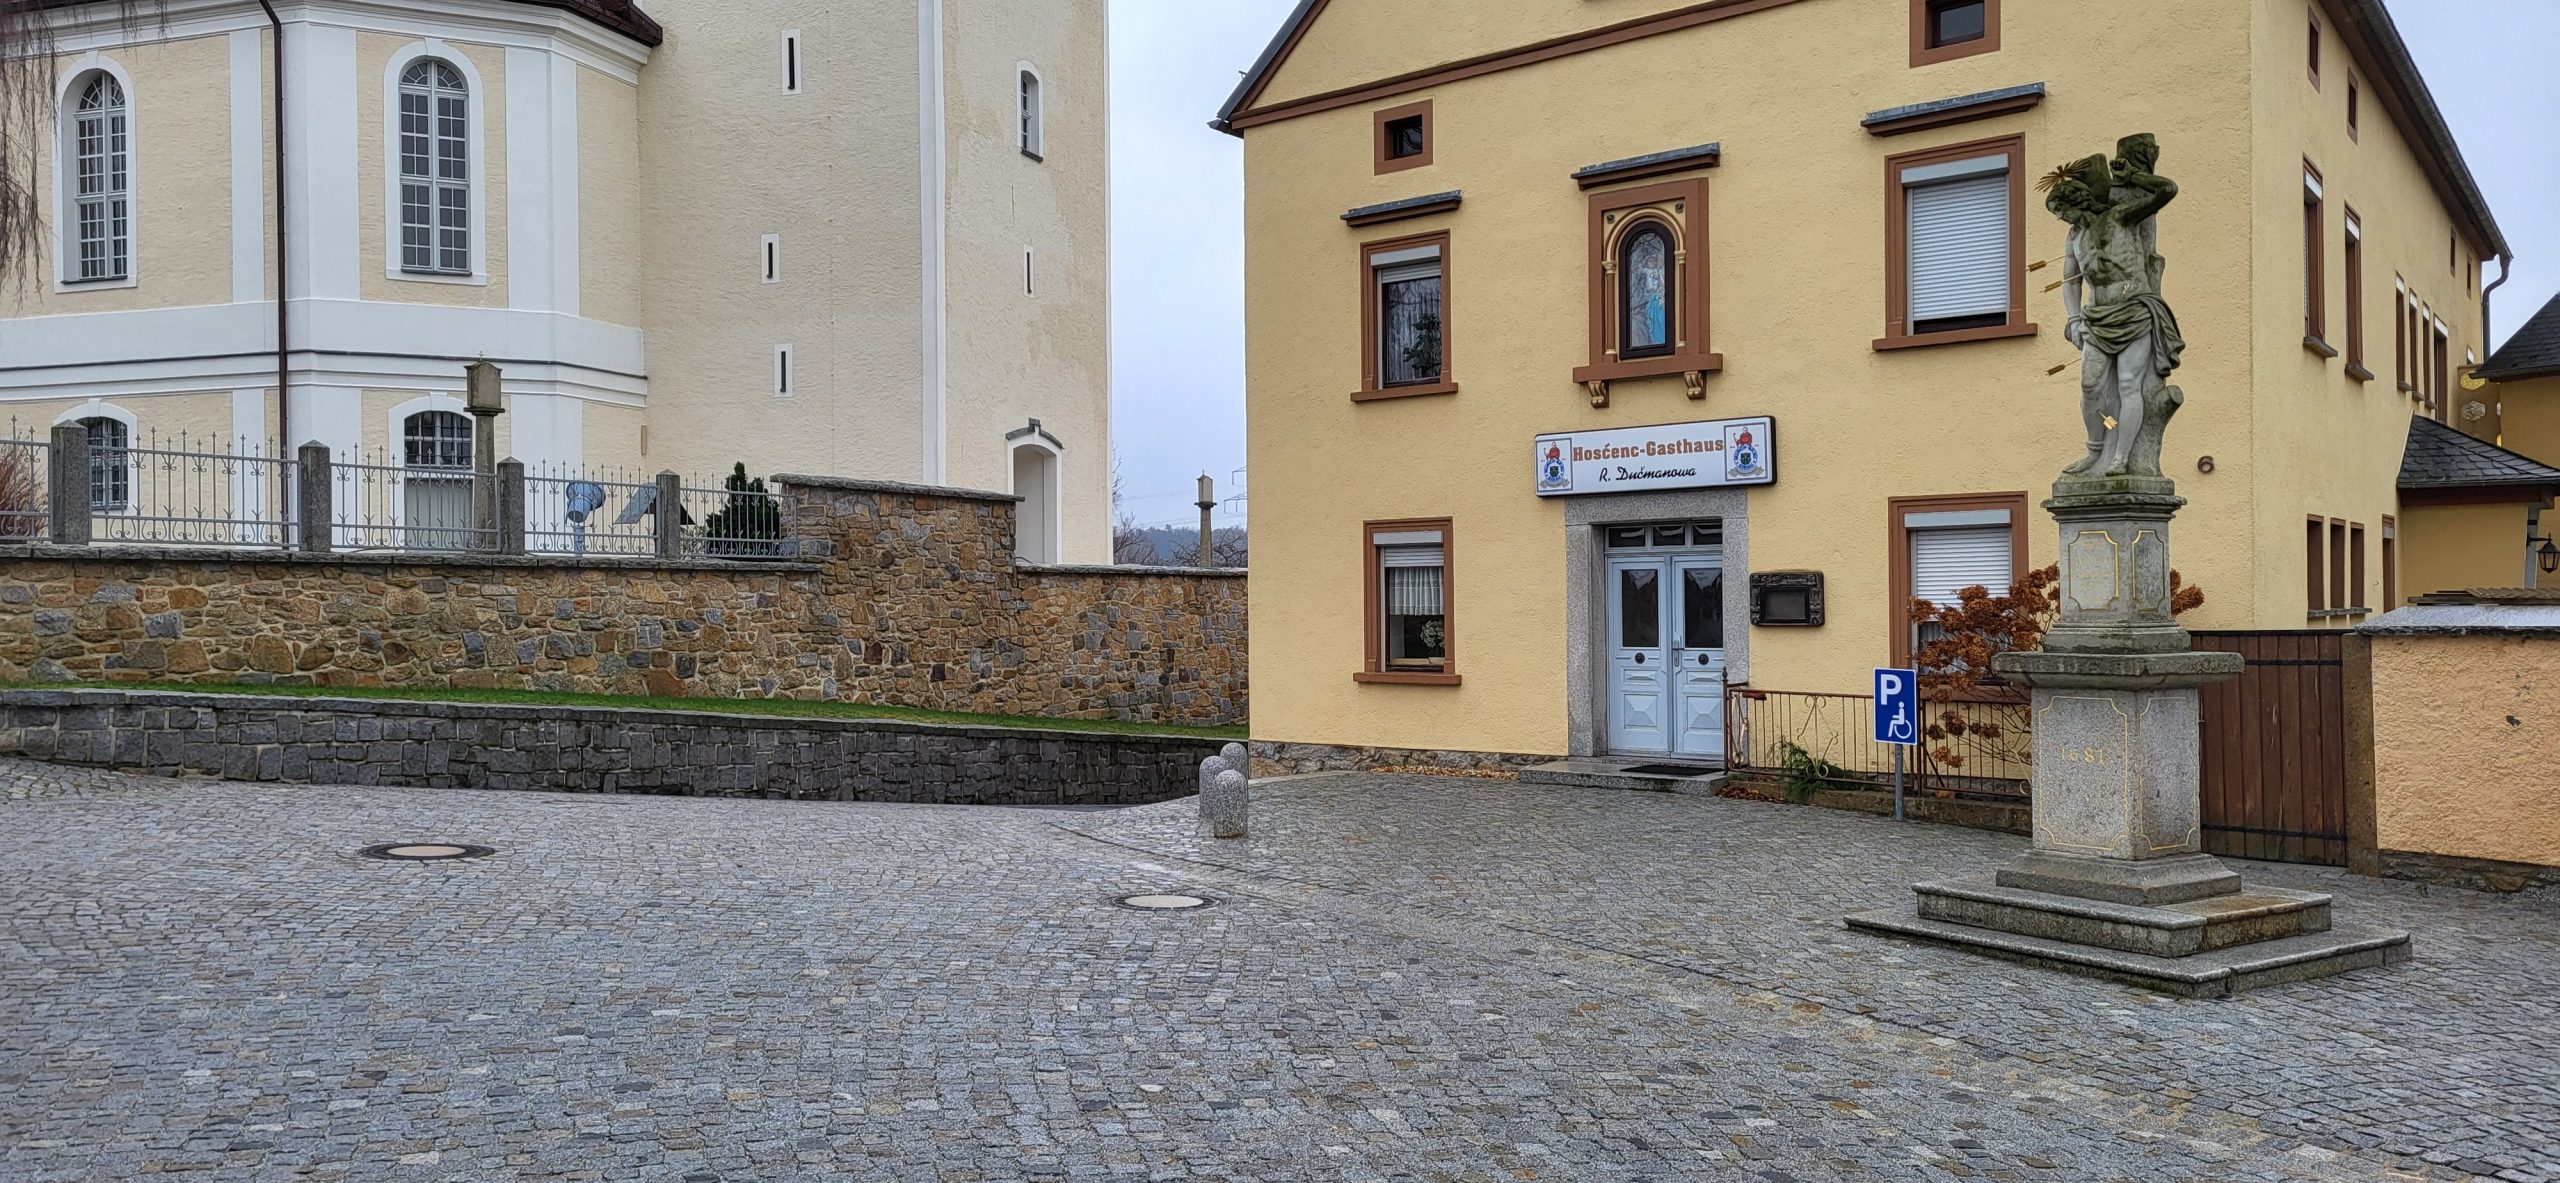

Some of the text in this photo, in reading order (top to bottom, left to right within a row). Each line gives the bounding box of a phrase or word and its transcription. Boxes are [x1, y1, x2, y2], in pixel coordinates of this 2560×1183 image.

[1572, 438, 1724, 462] Hosćenc-Gasthaus
[1598, 465, 1697, 483] R. Dučmanowa
[2197, 455, 2215, 474] 6
[1880, 673, 1903, 705] P
